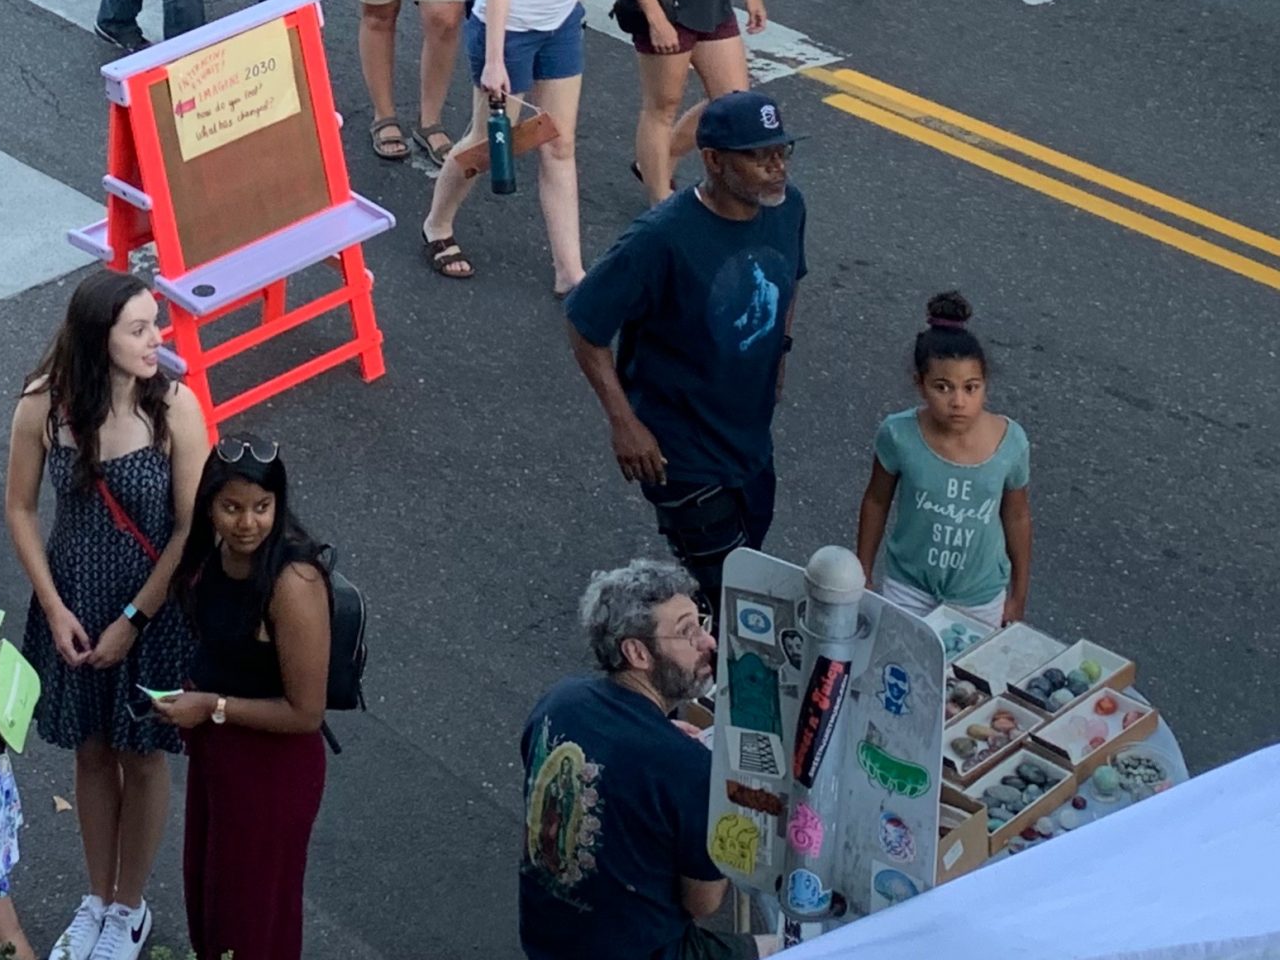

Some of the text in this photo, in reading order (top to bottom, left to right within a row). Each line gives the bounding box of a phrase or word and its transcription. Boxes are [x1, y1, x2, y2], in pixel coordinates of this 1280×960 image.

[244, 57, 276, 81] 2030
[215, 101, 226, 112] do
[228, 97, 242, 111] you
[219, 117, 234, 132] has
[946, 477, 972, 500] BE
[932, 523, 975, 548] STAY
[927, 547, 967, 570] COOL
[811, 659, 845, 710] Juicy
